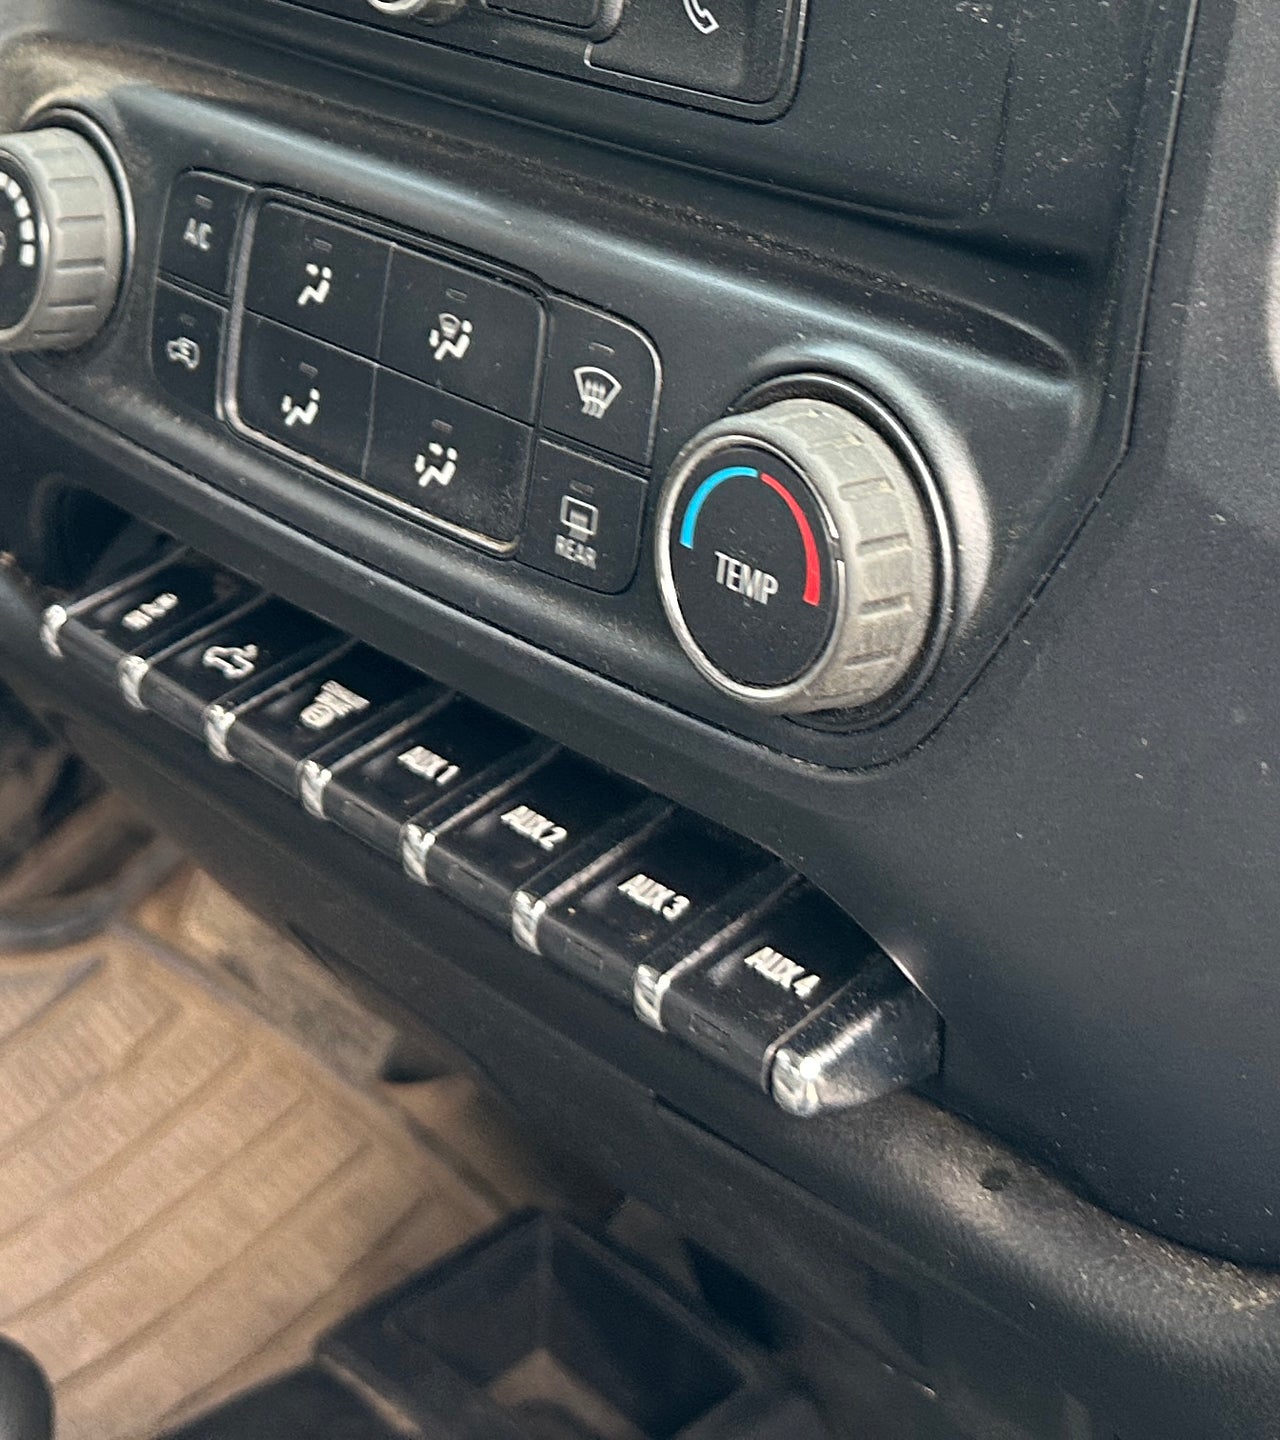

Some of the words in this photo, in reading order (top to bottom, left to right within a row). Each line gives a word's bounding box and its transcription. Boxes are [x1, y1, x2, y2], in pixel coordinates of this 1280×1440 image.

[554, 534, 597, 570] REAR
[714, 550, 779, 605] TEMP
[397, 745, 448, 778] AUX
[436, 764, 460, 785] 1
[501, 805, 554, 841] AUX
[539, 826, 568, 851] 2
[617, 873, 676, 914] AUX
[662, 895, 691, 922] 3
[743, 946, 805, 992] AUX
[792, 974, 820, 1000] 4
